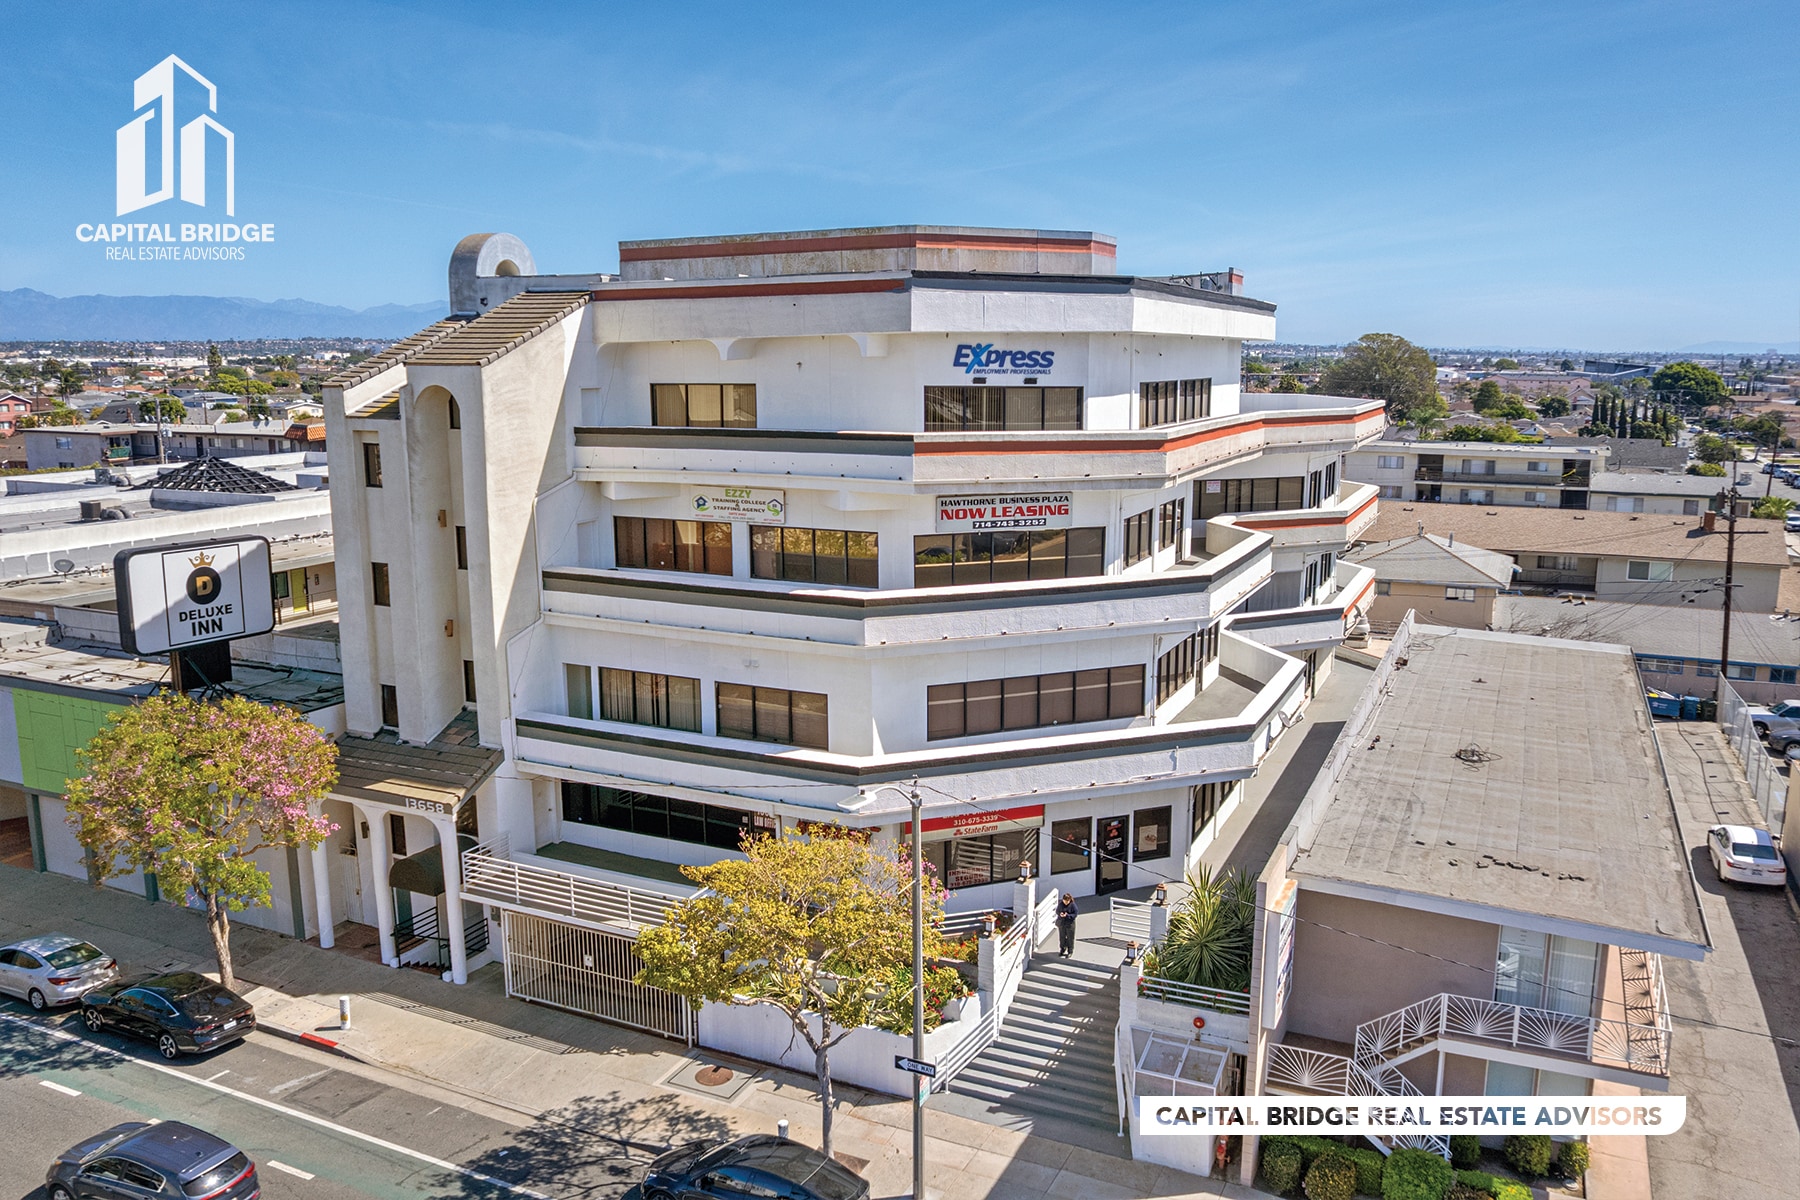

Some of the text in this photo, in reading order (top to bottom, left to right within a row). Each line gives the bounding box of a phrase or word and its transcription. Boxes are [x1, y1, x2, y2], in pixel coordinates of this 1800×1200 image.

[725, 488, 752, 499] EZZY
[941, 495, 1070, 507] HAWTHORNE BUSINESS PLAZA
[940, 504, 1069, 521] NOW LEASING
[974, 519, 1046, 528] 714-743-3252
[195, 575, 213, 596] D
[179, 603, 233, 622] DELUXE
[191, 617, 223, 637] INN
[405, 797, 444, 814] 13658
[953, 814, 999, 826] 310-675-3339
[920, 1065, 933, 1073] WAY
